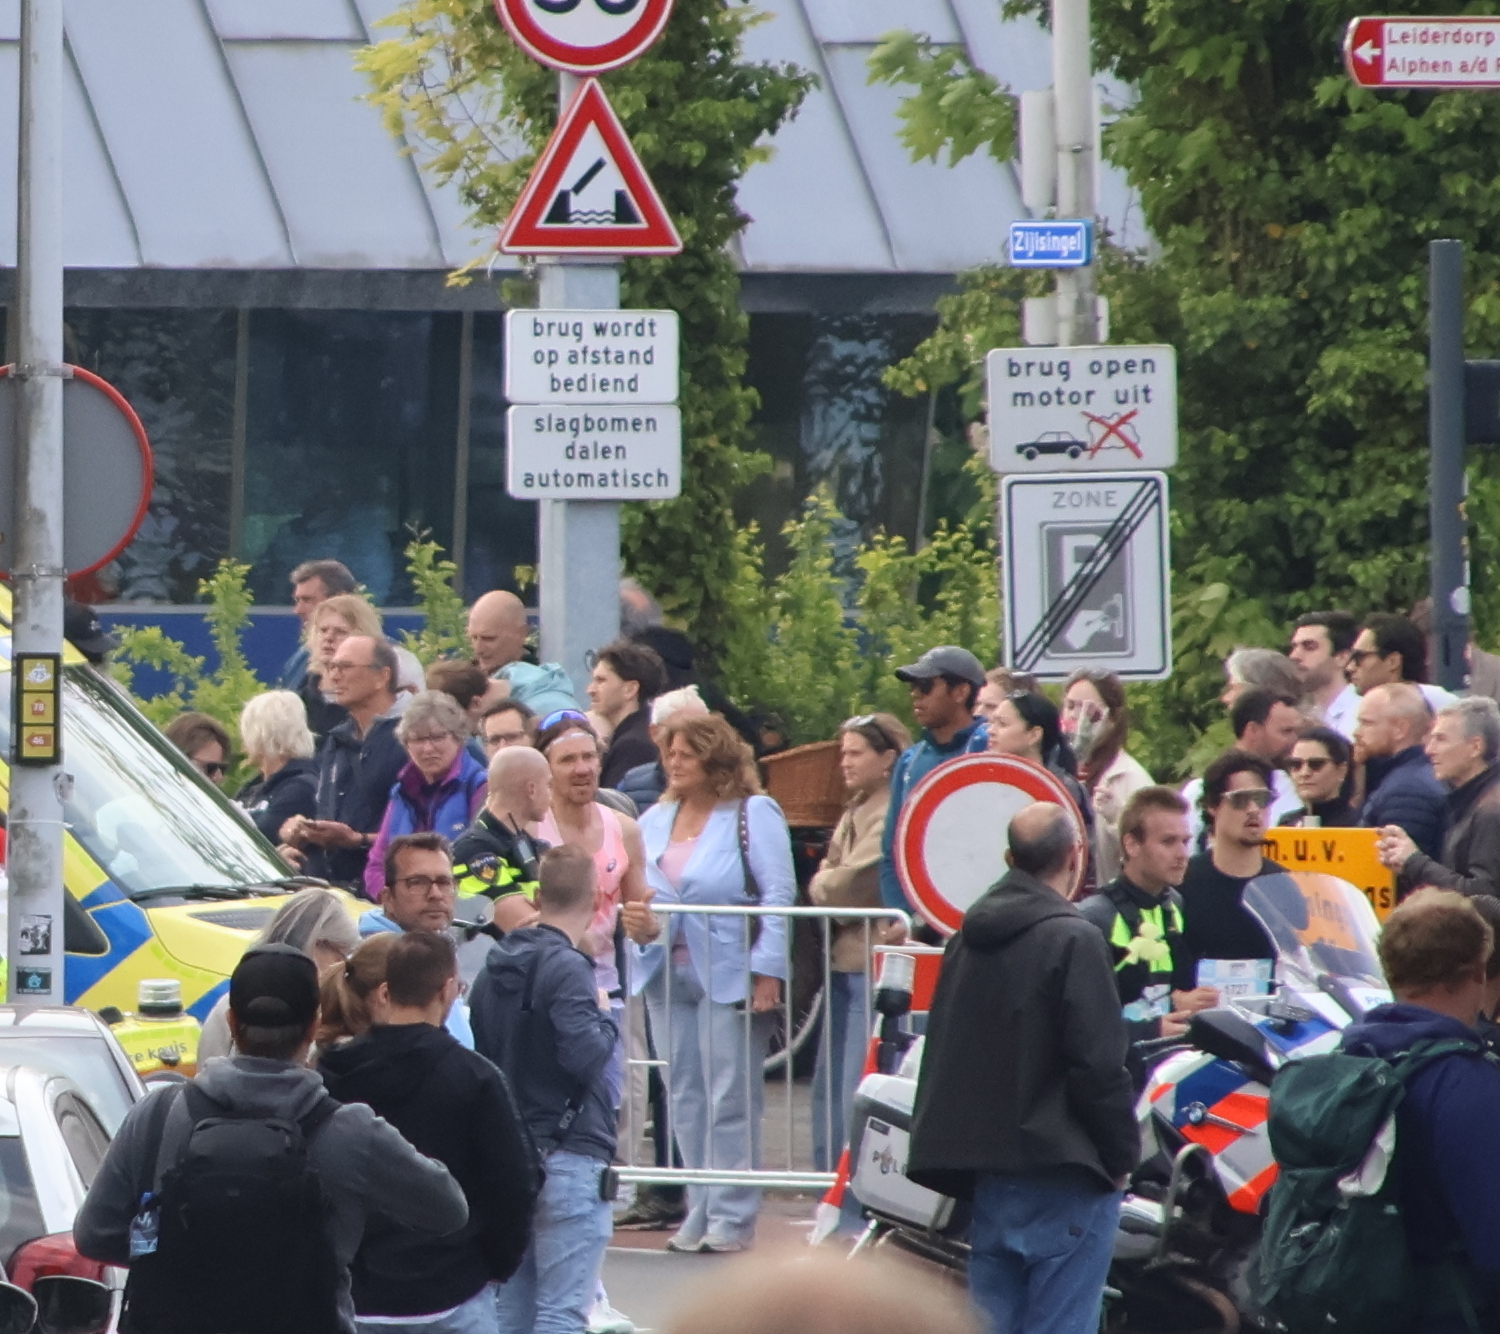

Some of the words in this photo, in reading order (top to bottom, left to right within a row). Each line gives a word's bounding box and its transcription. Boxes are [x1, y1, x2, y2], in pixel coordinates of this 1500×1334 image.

[1387, 28, 1495, 46] Leiderdorp
[1386, 56, 1452, 75] Alphen
[1459, 55, 1488, 73] a/d
[1012, 230, 1082, 258] Zijlsingel
[533, 317, 584, 342] brug
[593, 317, 657, 337] wordt
[533, 348, 560, 368] op
[567, 345, 655, 365] afstand
[1007, 357, 1071, 382] brug
[1089, 357, 1156, 379] open
[550, 372, 639, 393] bediend
[1012, 387, 1096, 407] motor
[1114, 385, 1153, 405] uit
[534, 413, 658, 438] slagbomen
[565, 440, 627, 460] dalen
[522, 468, 670, 488] automatisch
[1052, 490, 1118, 509] ZONE
